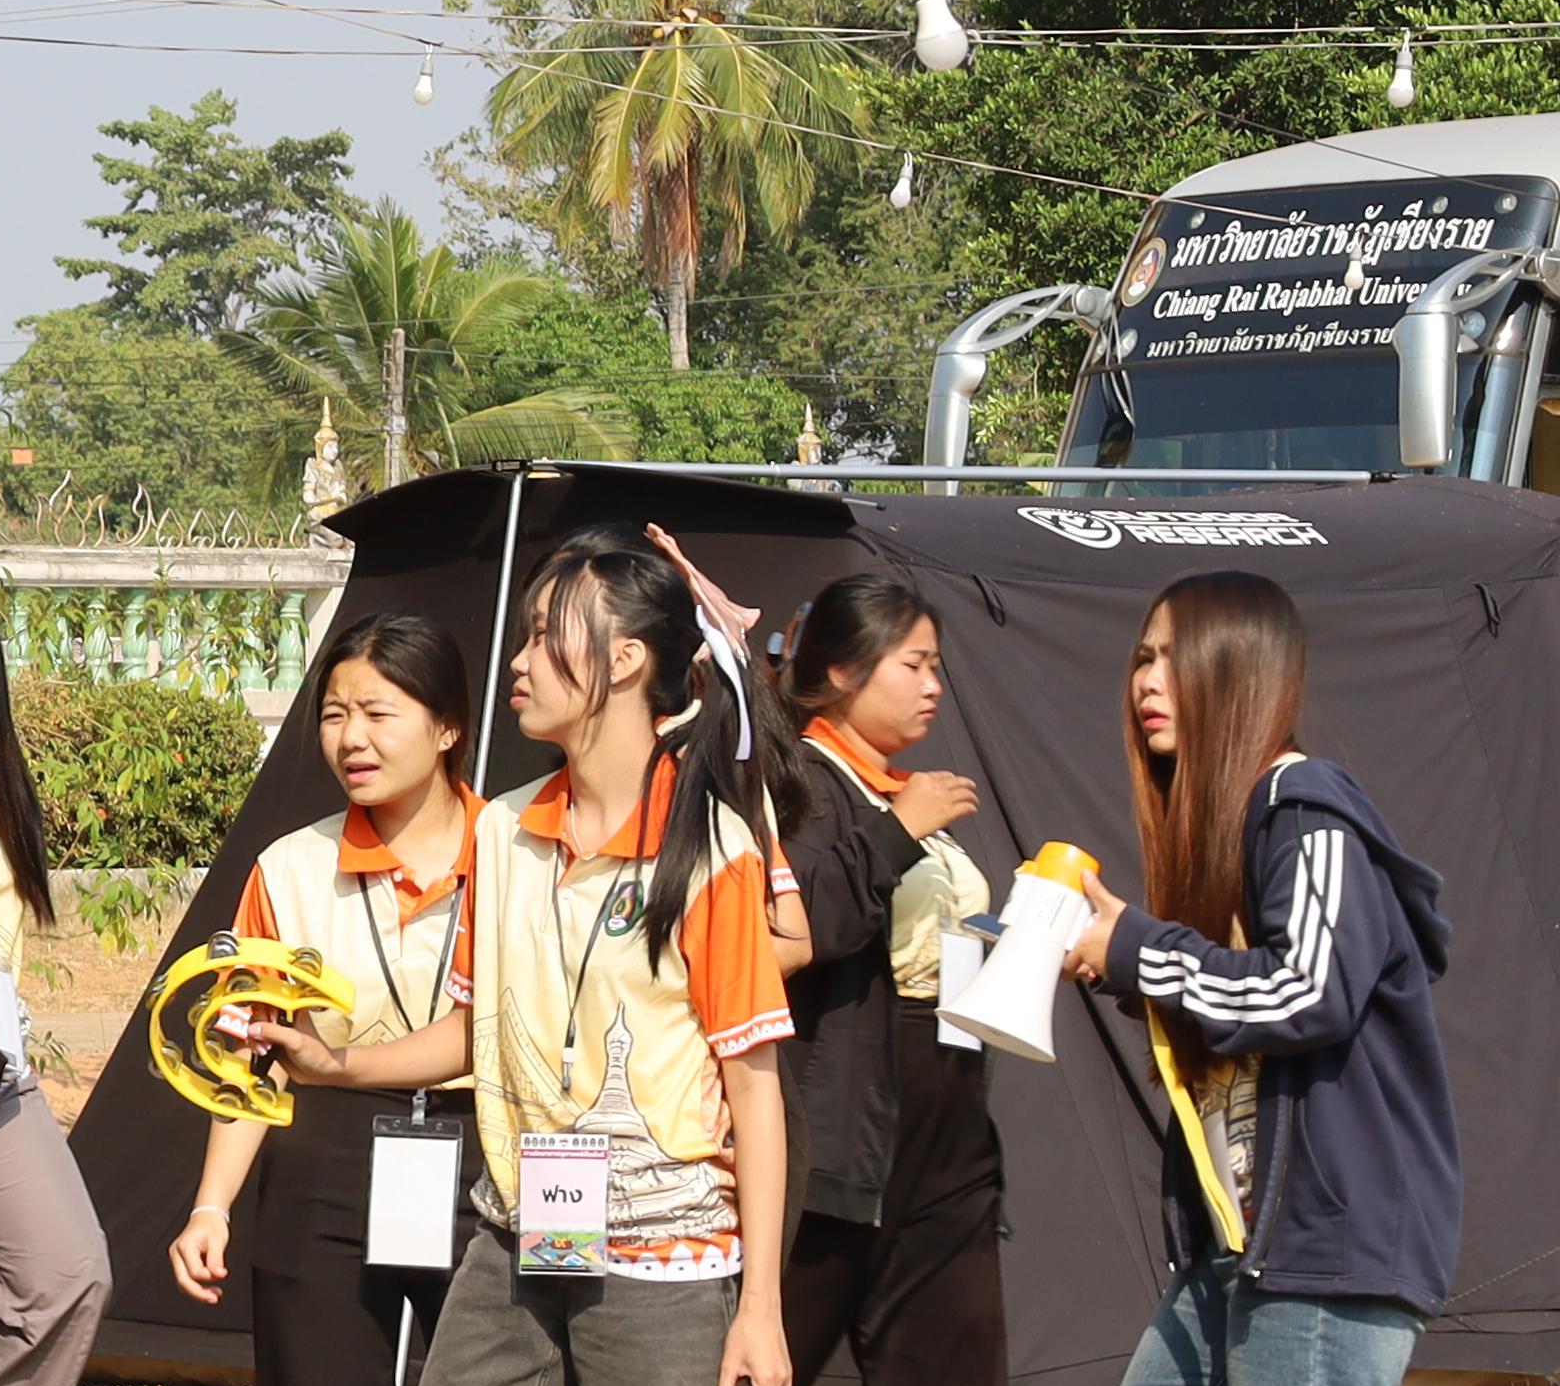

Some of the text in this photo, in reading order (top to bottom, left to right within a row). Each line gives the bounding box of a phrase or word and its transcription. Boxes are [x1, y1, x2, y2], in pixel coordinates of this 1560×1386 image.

[1152, 289, 1219, 322] Chiang
[1221, 285, 1264, 313] Rai
[1123, 524, 1329, 546] RESEARCH
[541, 1184, 584, 1203] ฟาง
